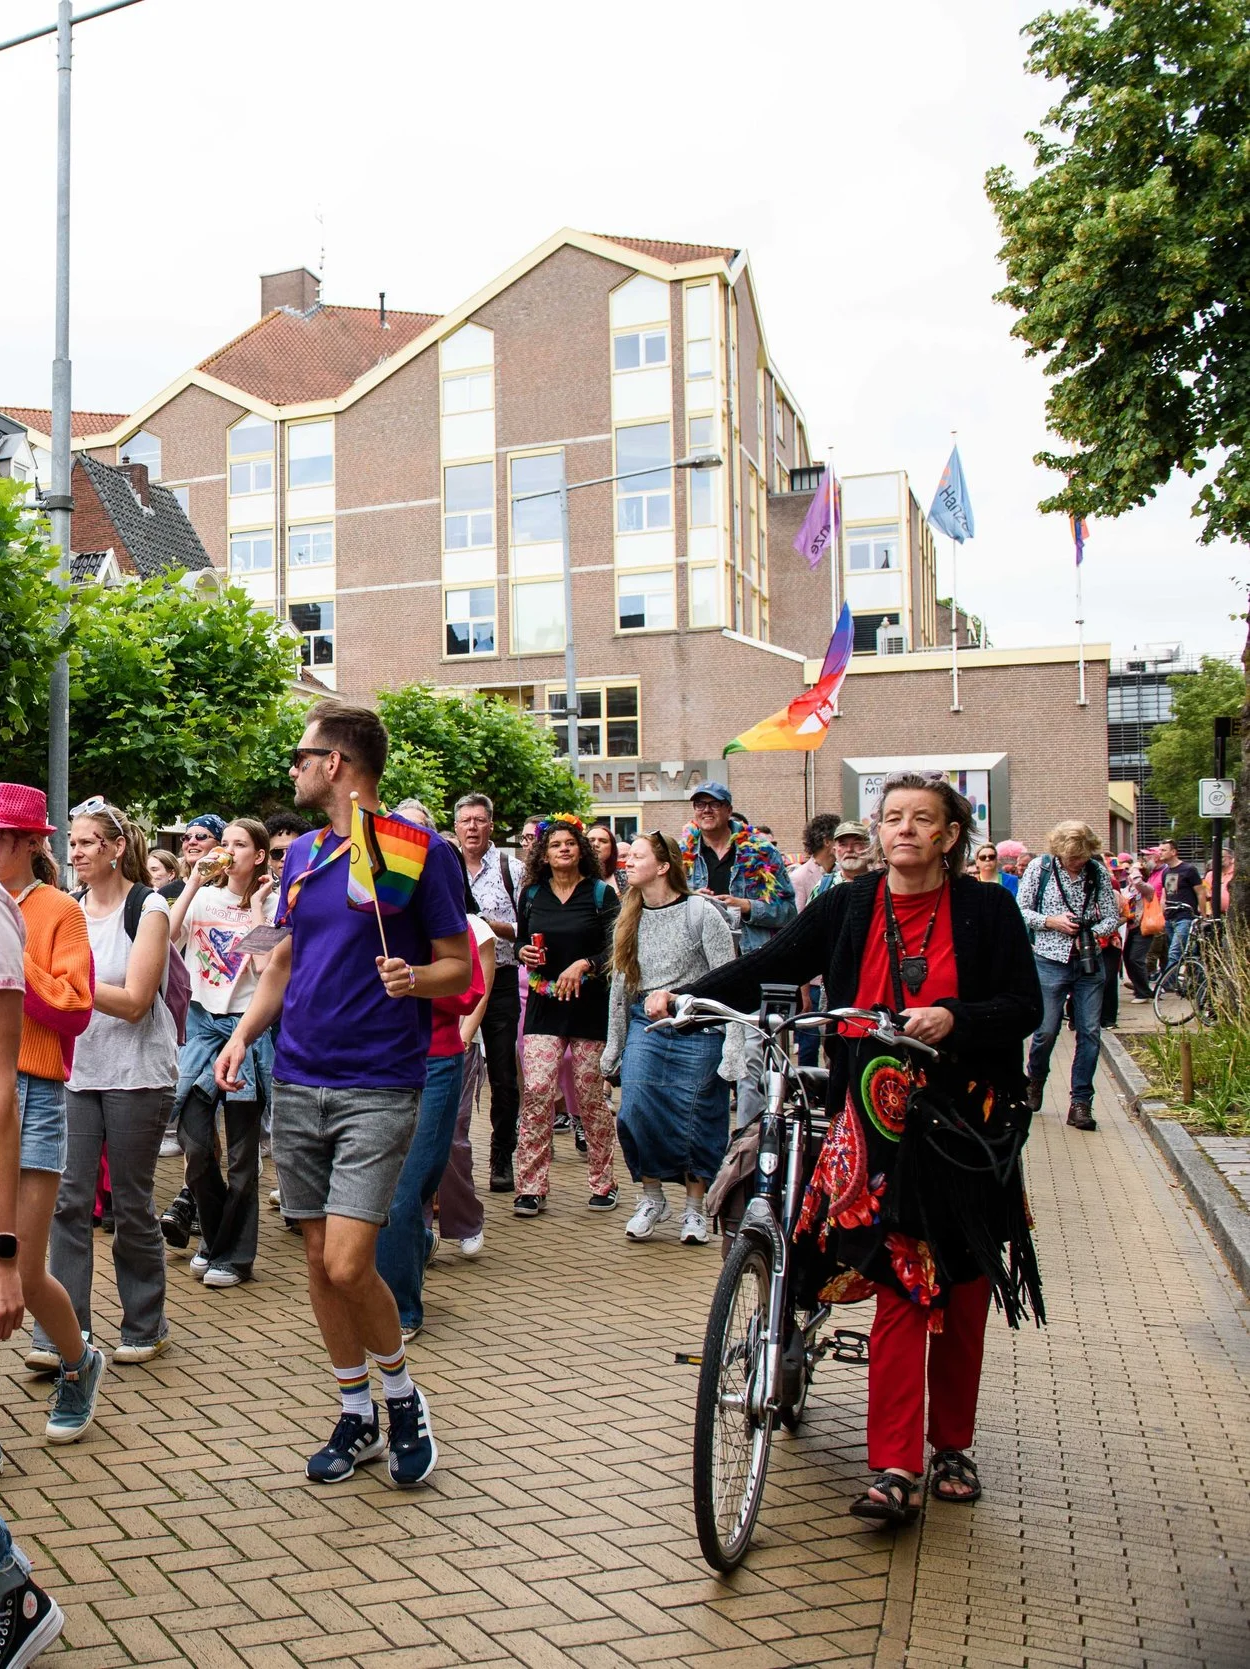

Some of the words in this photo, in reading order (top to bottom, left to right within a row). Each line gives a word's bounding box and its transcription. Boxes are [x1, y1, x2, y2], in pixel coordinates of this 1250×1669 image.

[939, 484, 969, 532] Hanze
[1212, 794, 1223, 802] 87
[205, 904, 252, 924] HOLID
